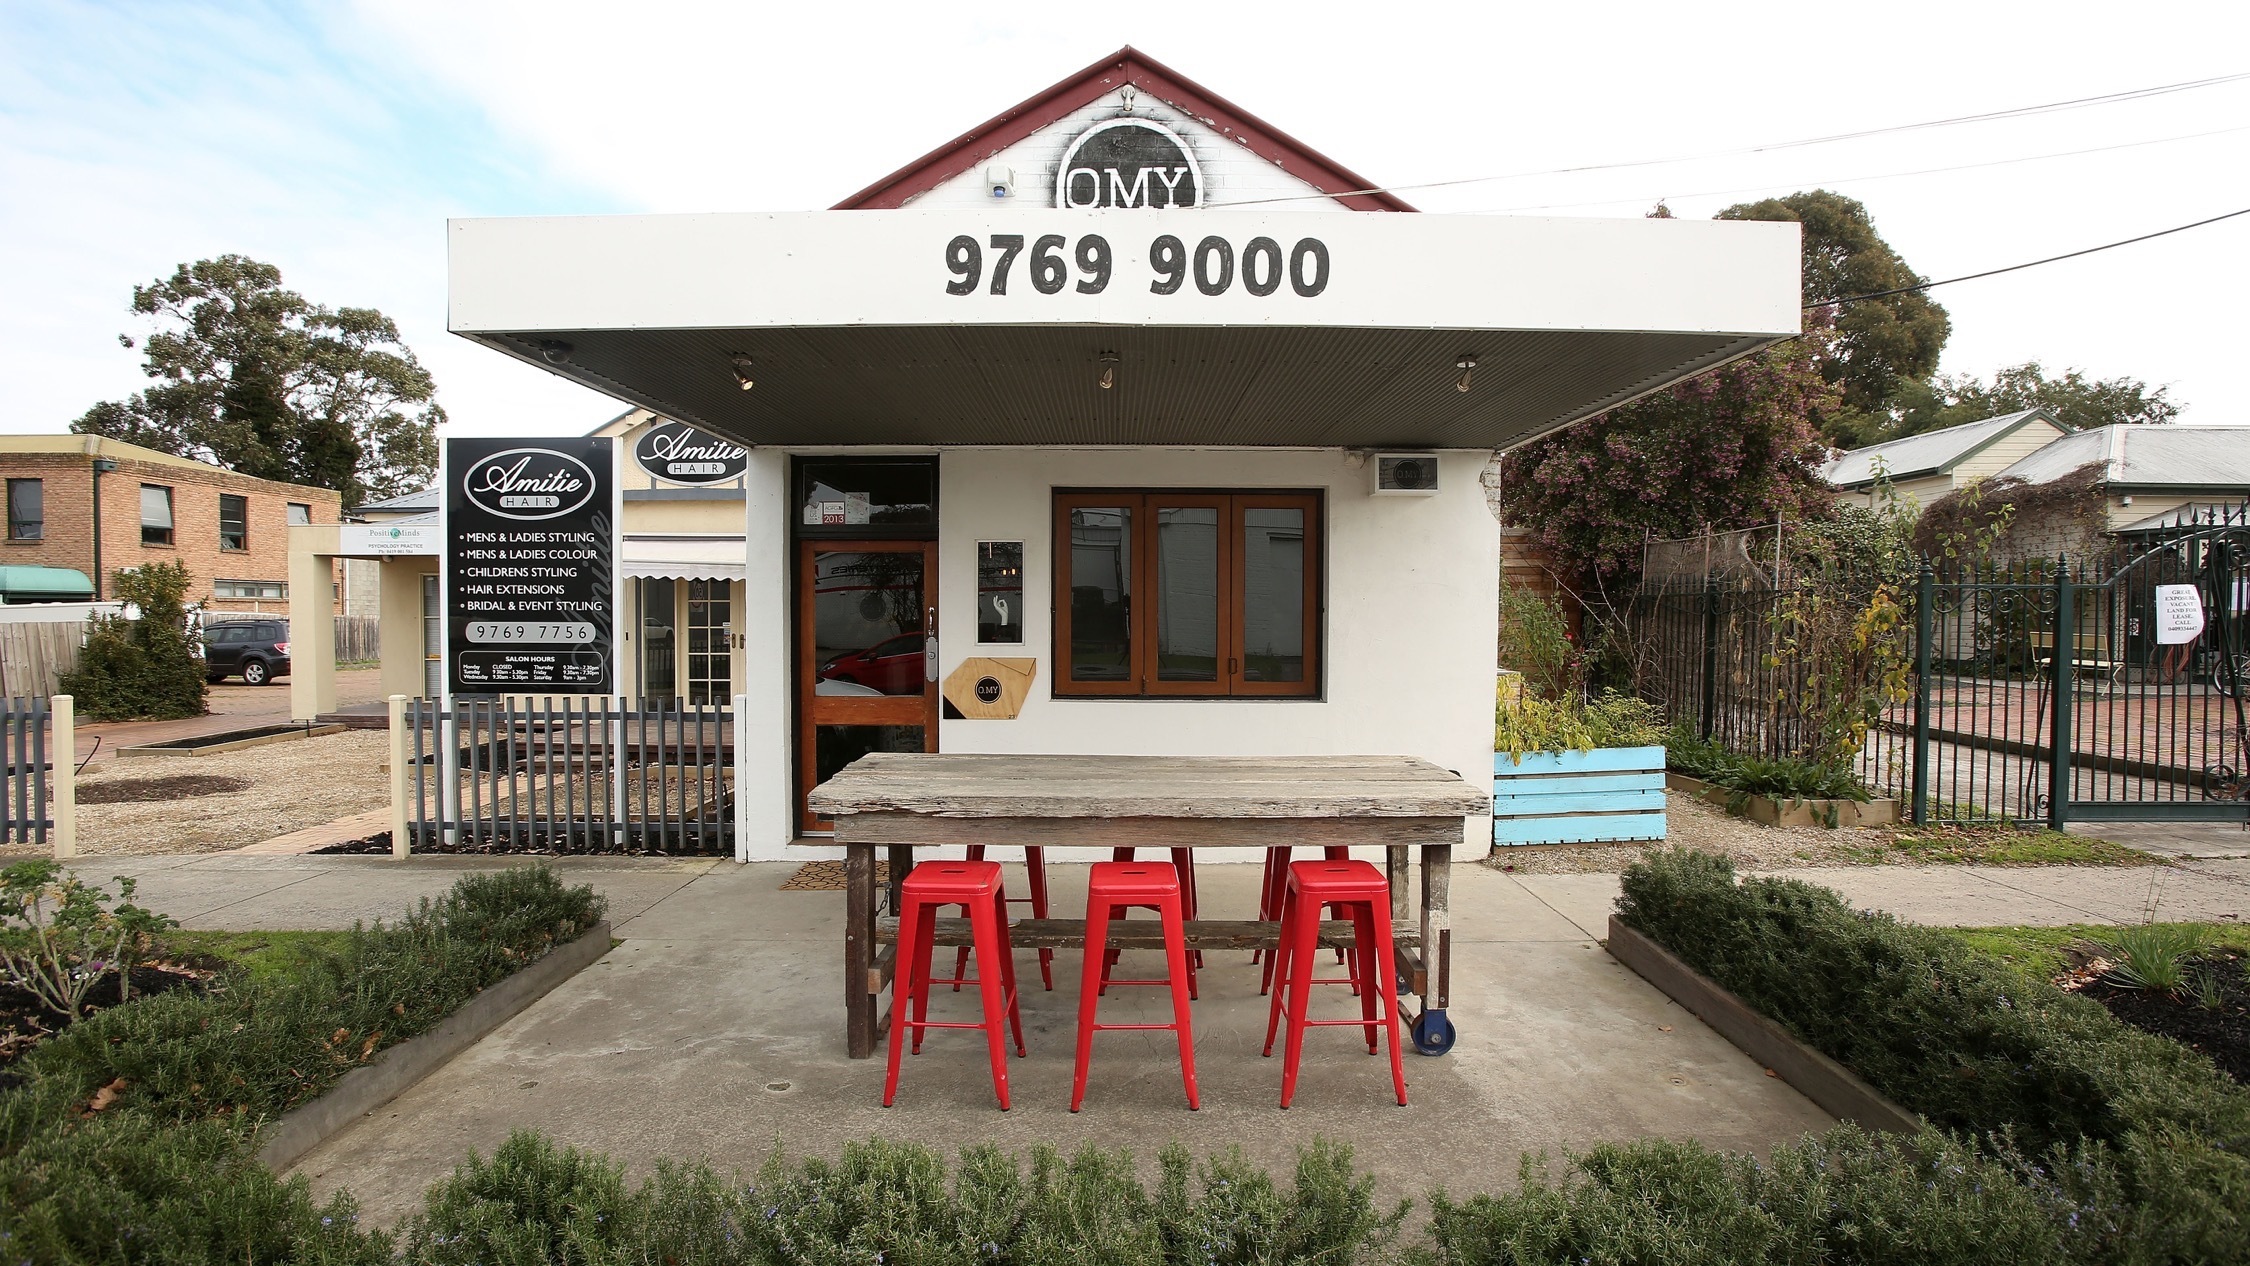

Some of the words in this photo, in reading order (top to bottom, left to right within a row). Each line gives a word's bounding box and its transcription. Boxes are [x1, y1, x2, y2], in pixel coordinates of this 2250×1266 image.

[945, 234, 1113, 296] 9769
[1149, 234, 1330, 298] 9000
[640, 427, 748, 461] Amitie
[673, 464, 719, 473] HAIR
[473, 455, 583, 493] Amitie
[506, 497, 553, 506] HAIR
[824, 515, 844, 523] 2013
[466, 532, 497, 543] MENS
[498, 532, 507, 543] &
[509, 532, 547, 543] LADIES
[548, 532, 596, 543] STYLING
[466, 550, 497, 560] MENS
[498, 550, 507, 560] &
[509, 550, 547, 560] LADIES
[548, 550, 598, 560] COLOUR
[467, 567, 529, 577] CHILDRENS
[531, 567, 577, 577] STYLING
[467, 584, 494, 595] HAIR
[496, 584, 565, 595] EXTENSIONS
[467, 601, 506, 611] BRIDAL
[508, 601, 517, 611] &
[518, 601, 554, 611] EVENT
[556, 601, 603, 611] STYLING
[476, 625, 525, 639] 9769
[538, 625, 587, 639] 7756
[978, 686, 998, 694] O.MY
